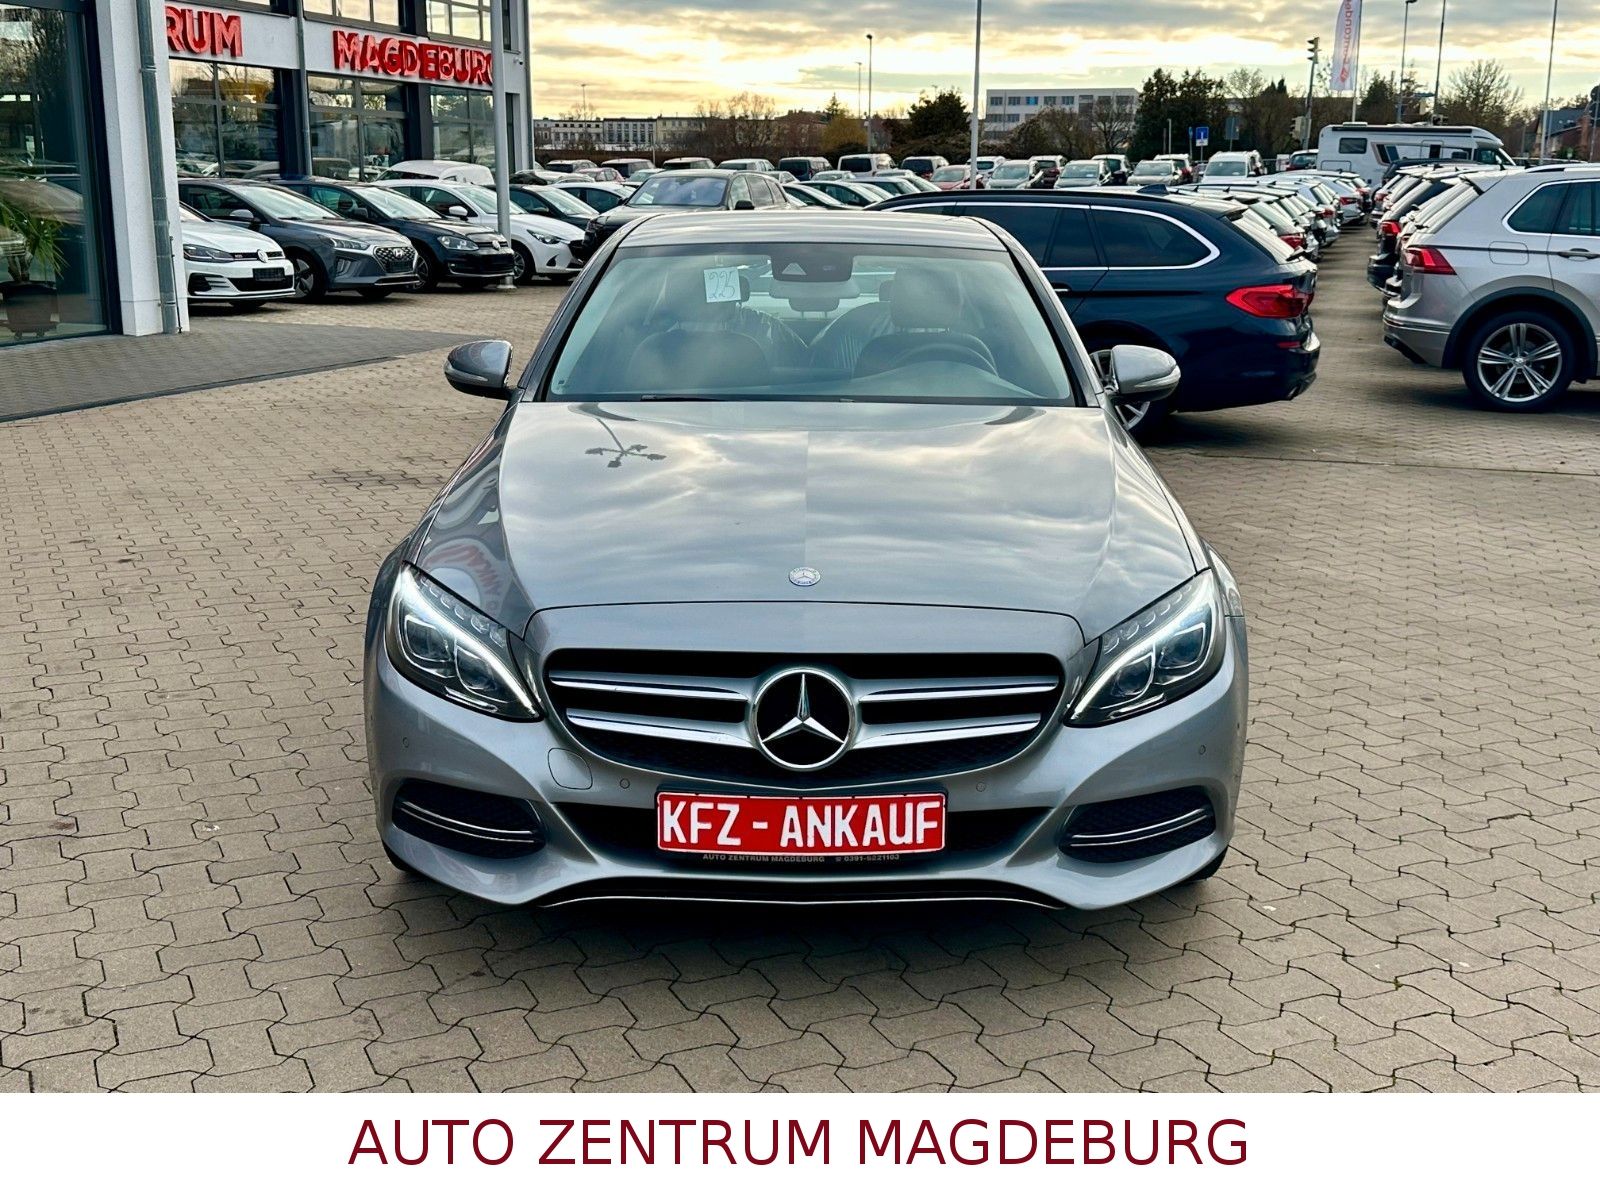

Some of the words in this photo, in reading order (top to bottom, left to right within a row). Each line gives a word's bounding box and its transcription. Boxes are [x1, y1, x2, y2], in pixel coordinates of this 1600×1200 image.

[663, 800, 741, 846] KFZ
[780, 801, 940, 847] ANKAUF
[771, 855, 825, 863] MAGDEBURG
